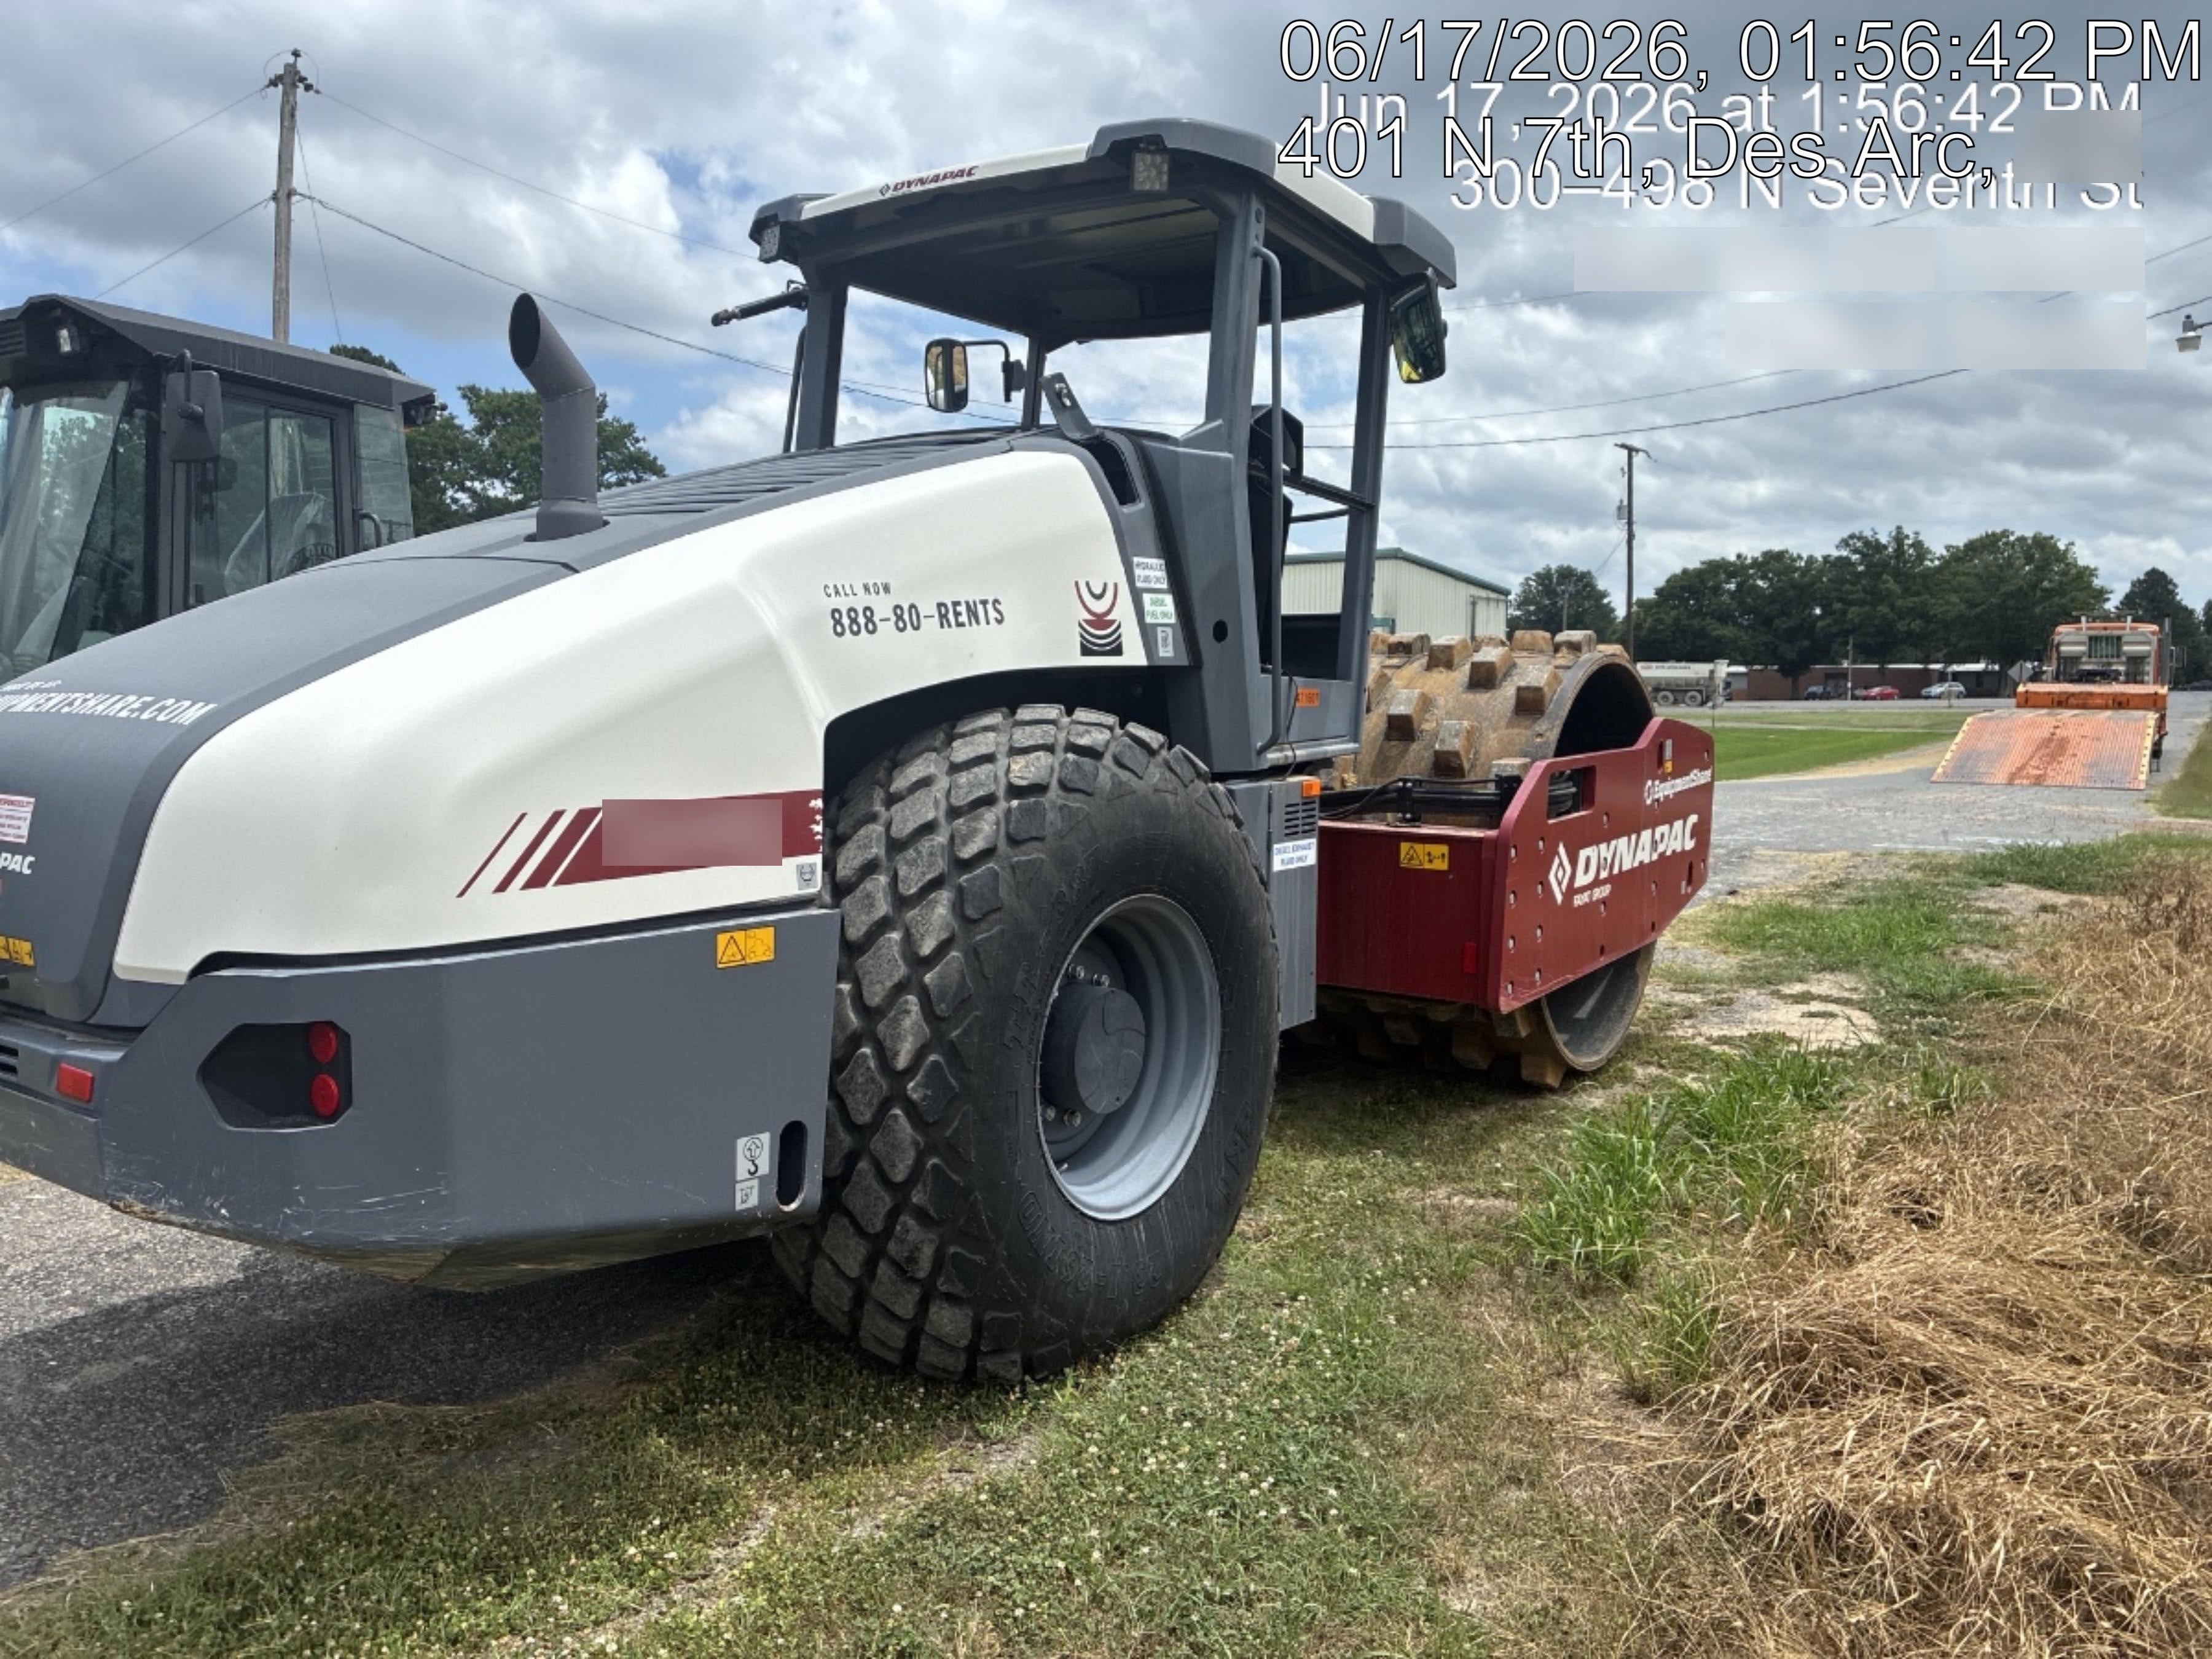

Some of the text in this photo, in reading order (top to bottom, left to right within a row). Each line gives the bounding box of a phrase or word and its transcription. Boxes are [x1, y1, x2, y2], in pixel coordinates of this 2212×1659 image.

[892, 165, 979, 192] DYNAPAC
[823, 582, 892, 598] CALL NOW
[830, 597, 1005, 638] 888-80-RENTS
[1574, 814, 1698, 888] DYNAPAC
